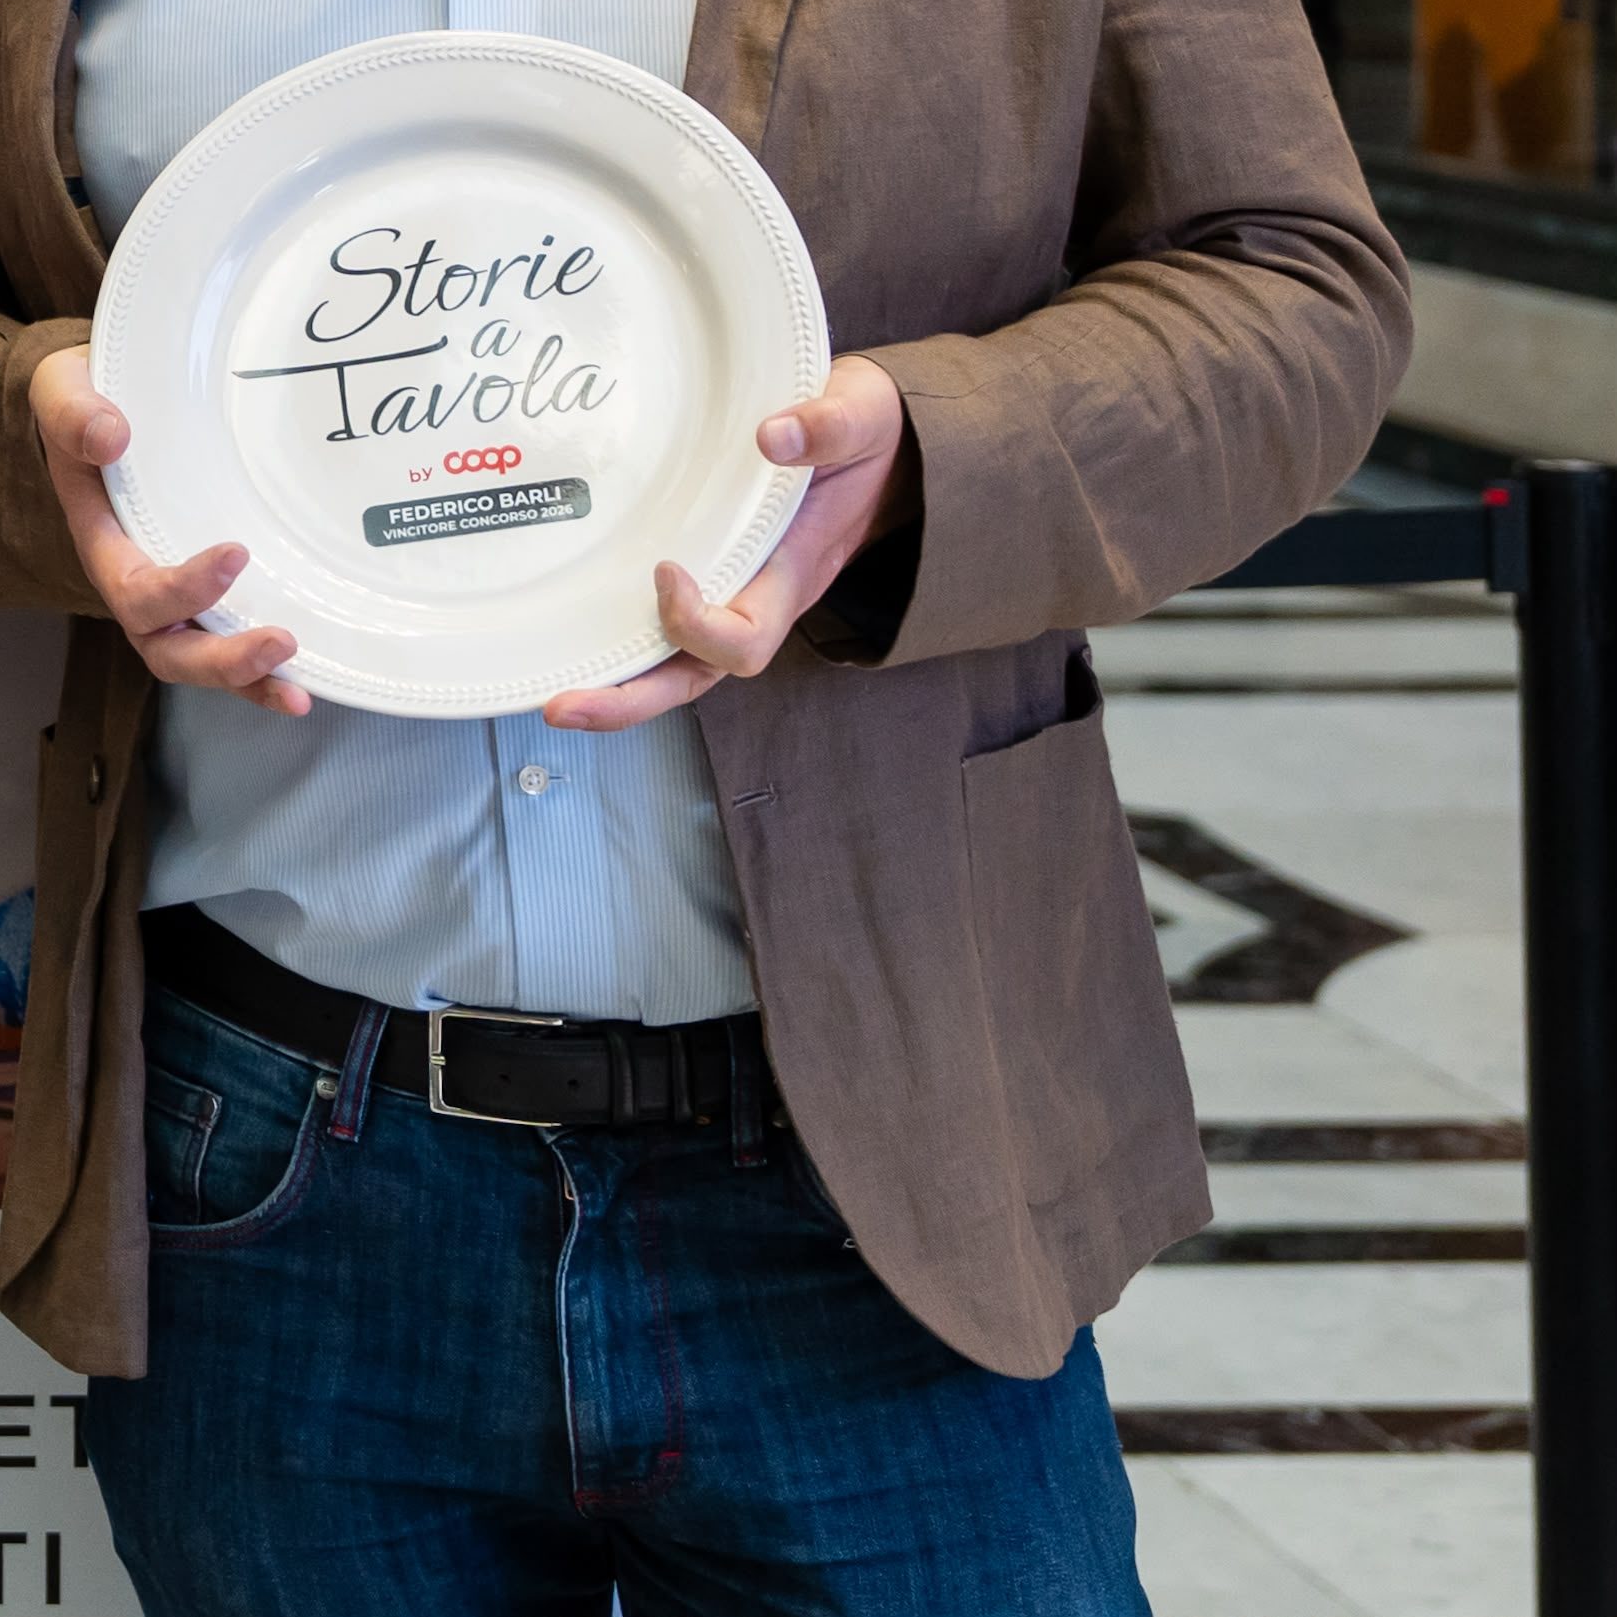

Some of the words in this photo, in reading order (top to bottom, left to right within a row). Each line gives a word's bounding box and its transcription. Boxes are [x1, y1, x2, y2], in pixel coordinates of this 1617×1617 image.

[304, 227, 605, 344] Storie
[470, 317, 522, 359] a
[231, 334, 619, 442] Tavola
[409, 466, 432, 483] by
[443, 444, 522, 475] coop
[383, 519, 457, 540] VINCITORE
[459, 508, 538, 529] CONCORSO
[540, 503, 574, 519] 2026
[388, 496, 494, 525] FEDERICO
[498, 486, 562, 509] BARLI
